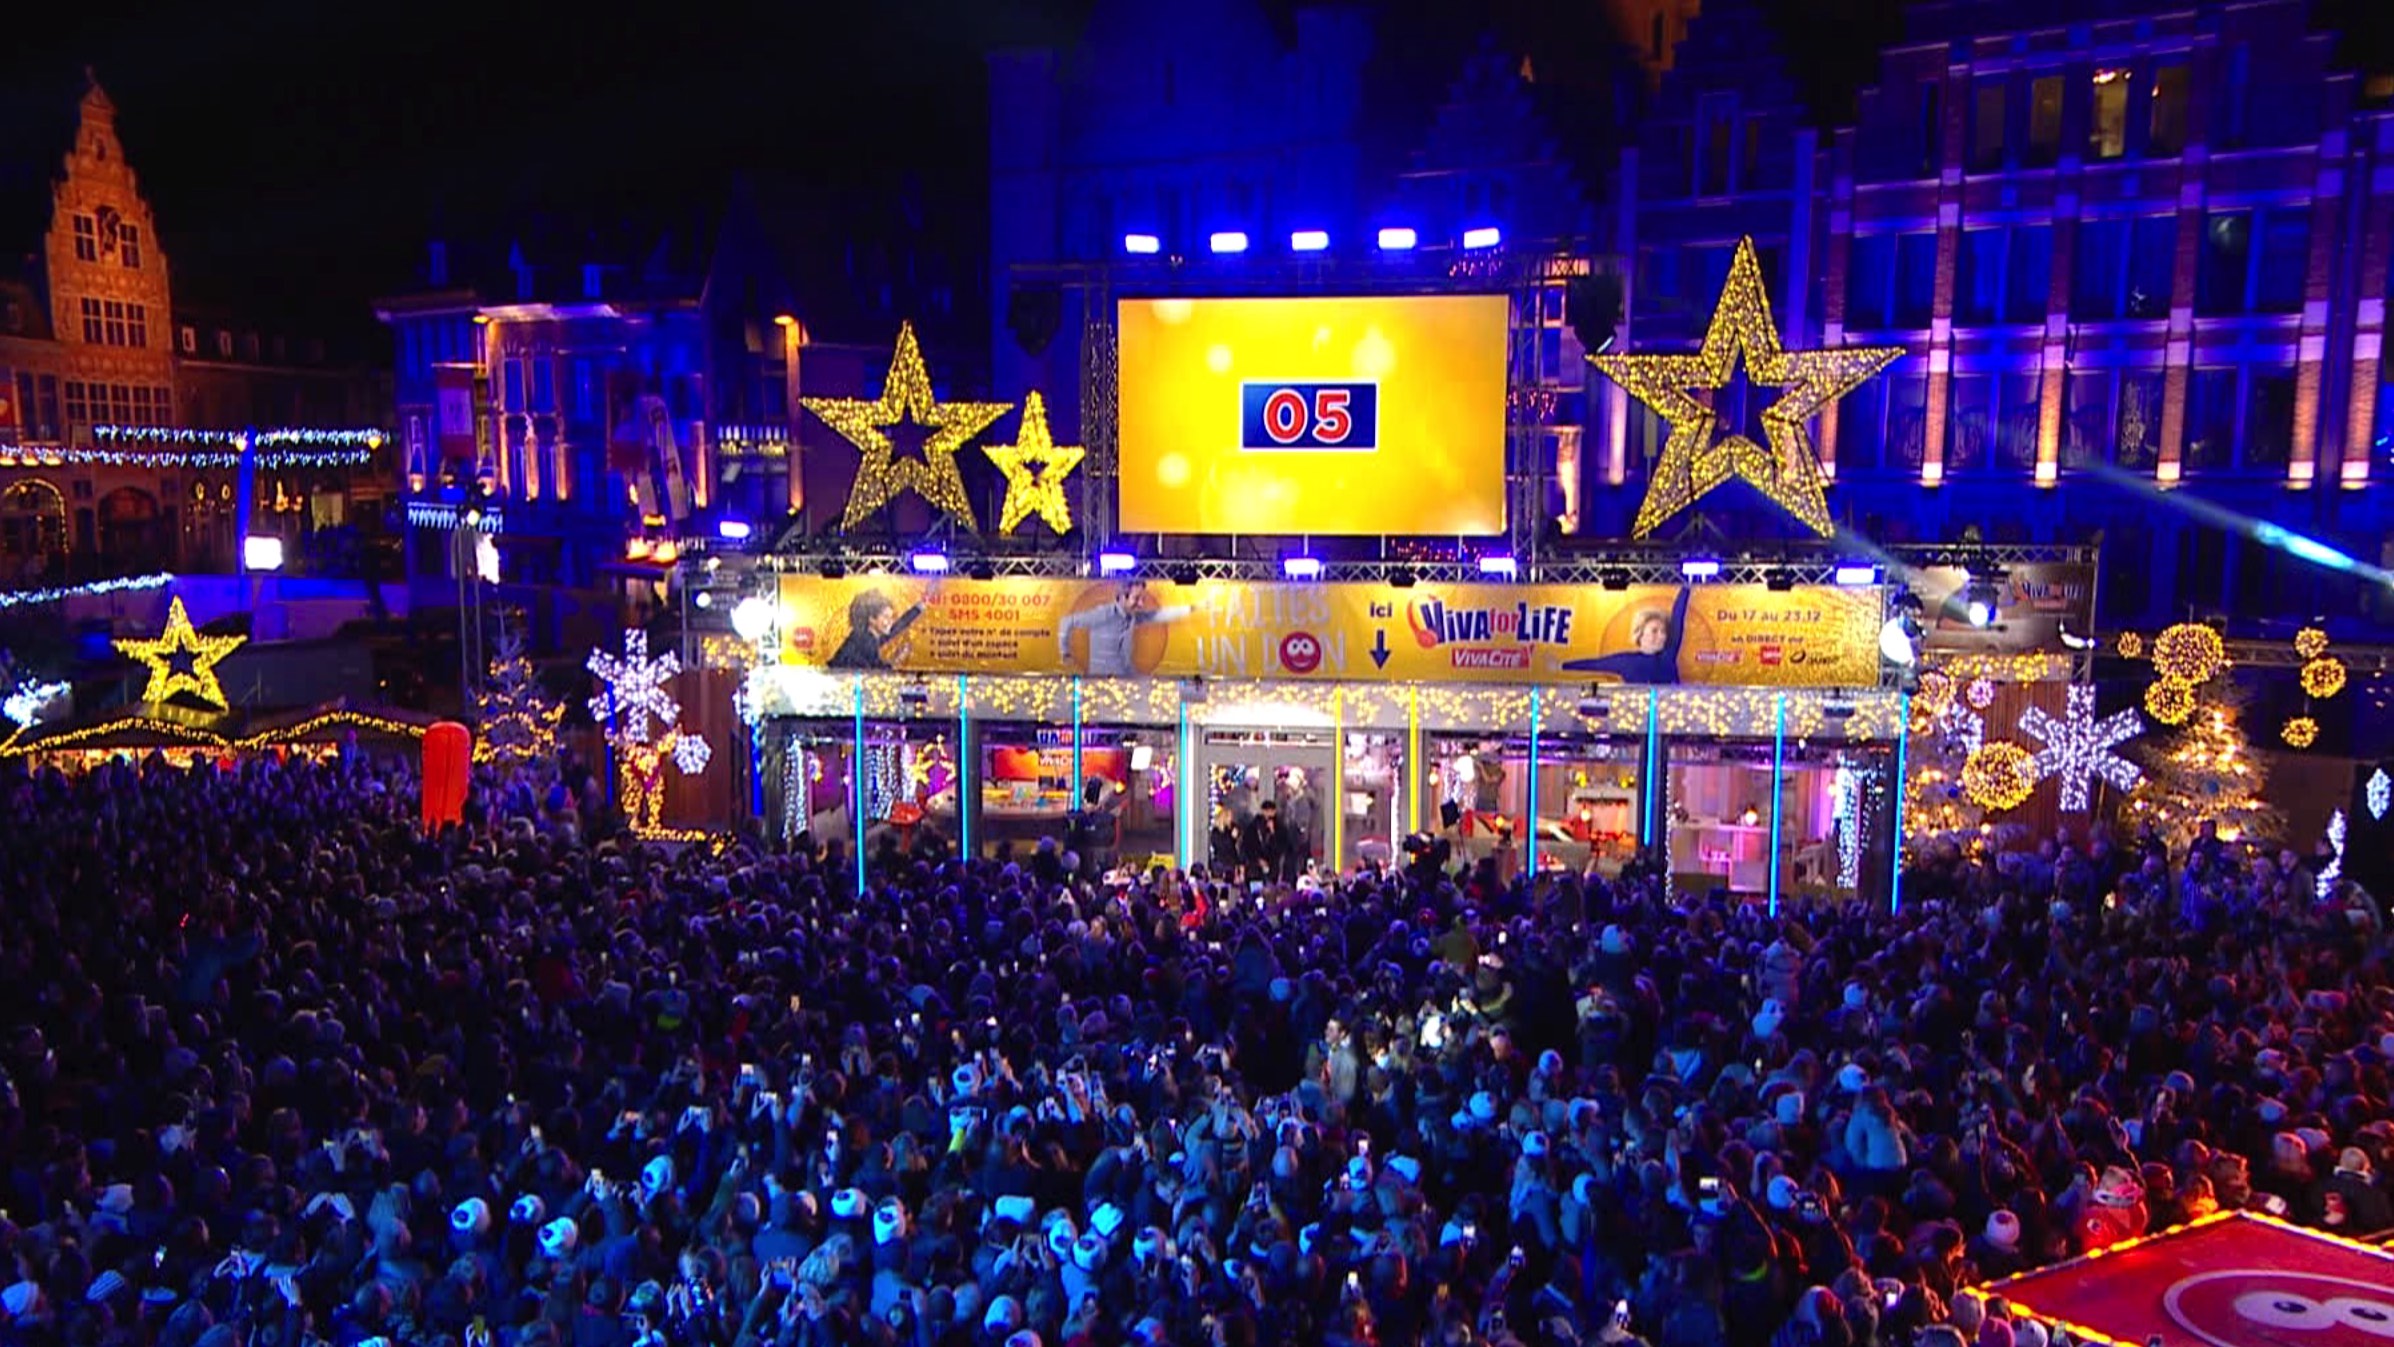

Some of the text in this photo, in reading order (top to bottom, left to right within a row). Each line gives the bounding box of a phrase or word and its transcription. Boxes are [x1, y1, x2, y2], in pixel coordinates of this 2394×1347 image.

[1263, 388, 1351, 443] 05
[1022, 594, 1050, 606] 007
[949, 609, 1020, 621] SMS 4001
[1717, 609, 1737, 621] Du
[1743, 610, 1756, 621] 17
